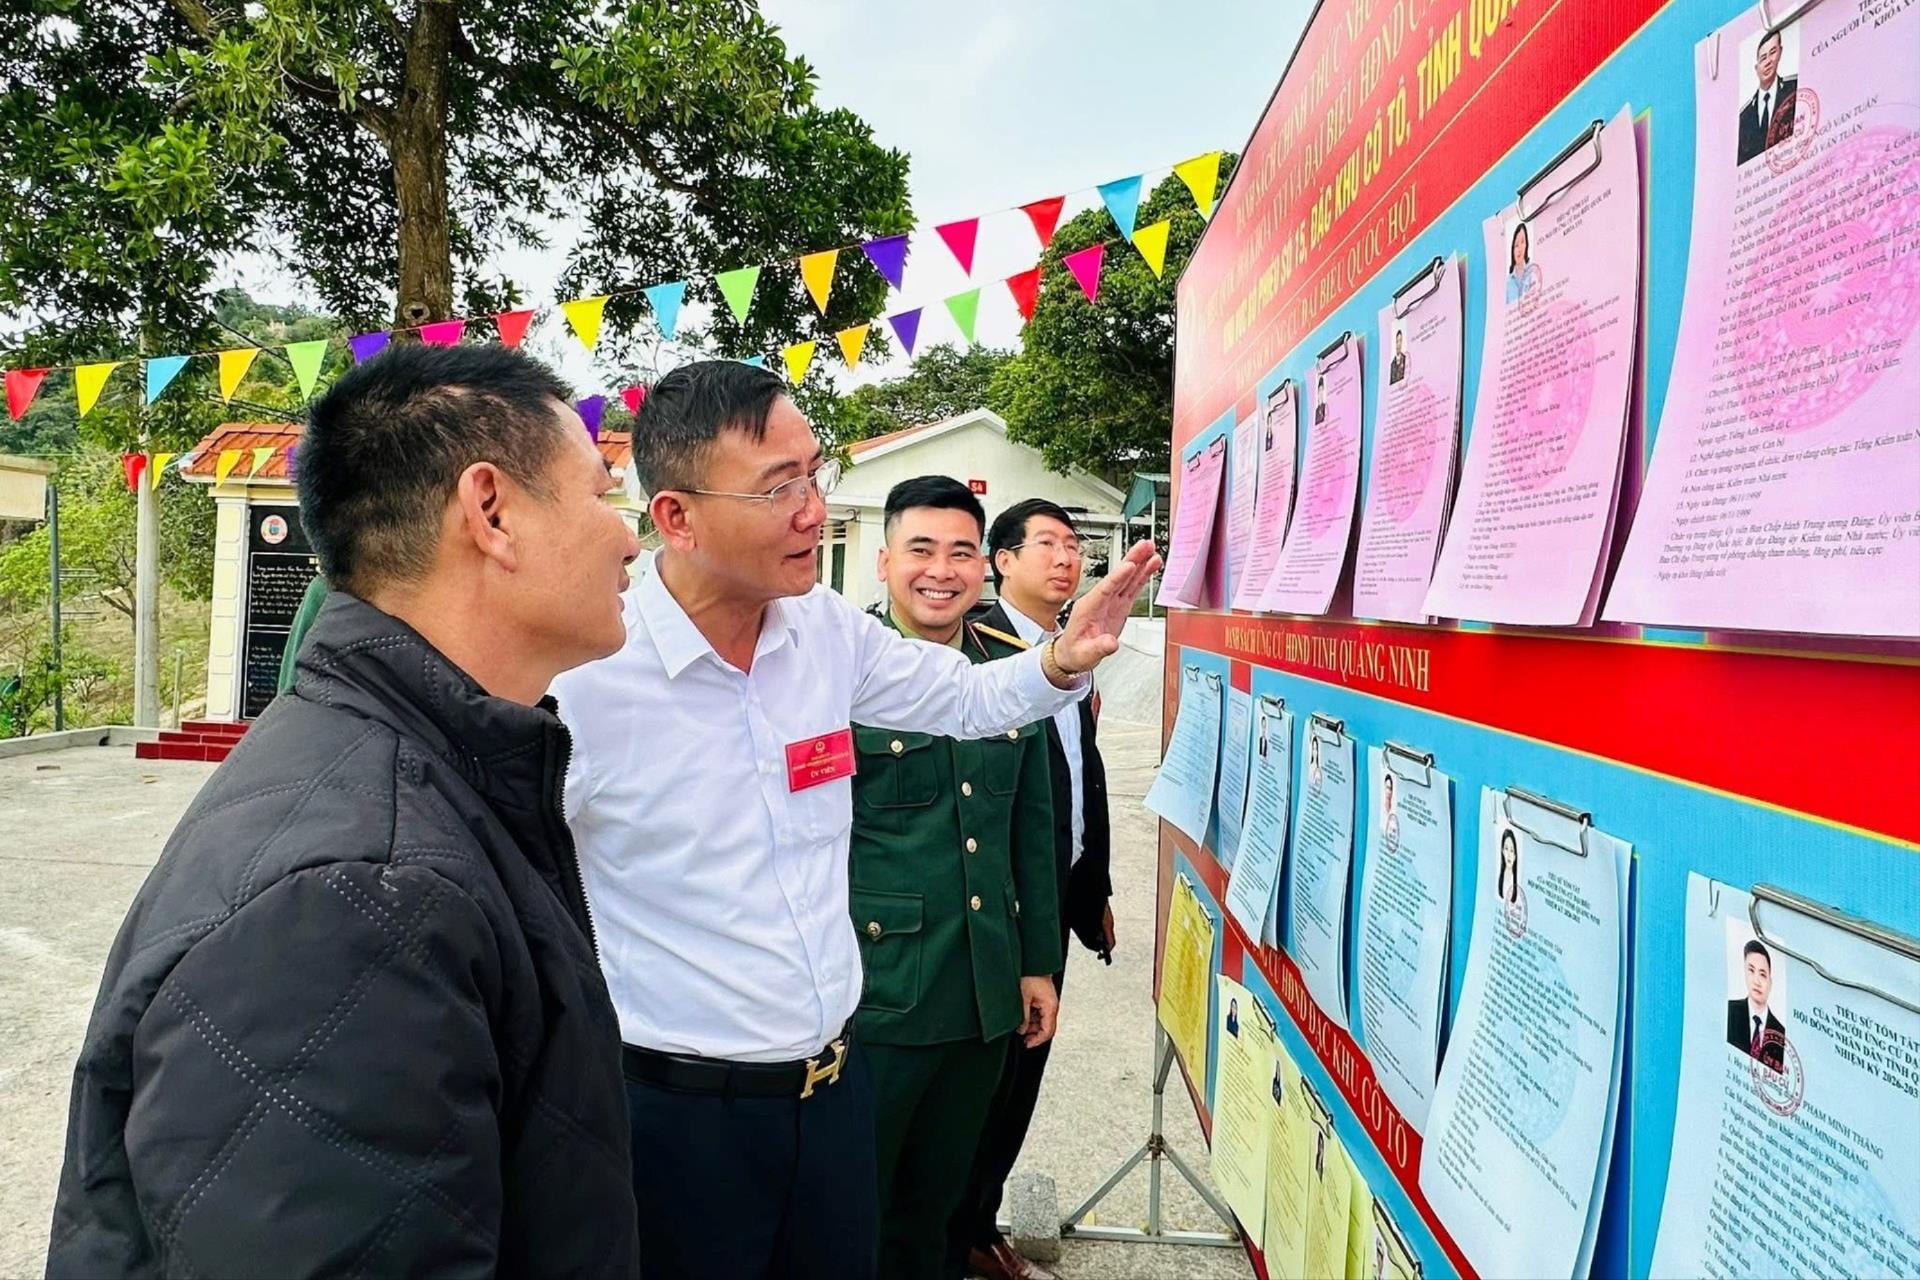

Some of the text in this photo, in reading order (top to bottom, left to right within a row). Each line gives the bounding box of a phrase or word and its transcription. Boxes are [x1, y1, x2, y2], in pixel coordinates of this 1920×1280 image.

[1360, 4, 1404, 108] HĐND
[1311, 184, 1331, 251] ĐẶC
[1335, 146, 1359, 220] KHU
[1363, 107, 1381, 186] CÔ
[1417, 13, 1461, 120] TỈNH
[1320, 260, 1342, 310] BIỂU
[1347, 217, 1384, 288] QUỐC
[1388, 183, 1415, 246] HỘI
[1802, 518, 1825, 534] Trung
[1285, 632, 1310, 665] HĐND
[1312, 627, 1337, 671] TỈNH
[1340, 631, 1385, 682] QUẢNG
[1389, 646, 1429, 691] NINH
[1812, 1006, 1902, 1059] CỦA NGƯỜI ỨNG CỬ
[1835, 1004, 1857, 1023] TIỂU
[1859, 1015, 1872, 1029] SỬ
[1874, 1022, 1897, 1042] TÓM
[1793, 1008, 1807, 1024] HỘI
[1810, 1017, 1833, 1038] ĐỒNG
[1835, 1031, 1860, 1052] NHÂN
[1863, 1045, 1882, 1063] DÂN
[1885, 1056, 1909, 1078] TỈNH
[1834, 1044, 1865, 1069] NHIỆM
[1867, 1062, 1880, 1076] KỲ
[1281, 964, 1307, 1019] HĐND
[1333, 1035, 1360, 1097] KHU
[1361, 1076, 1382, 1132] CÔ
[1385, 1104, 1407, 1168] TÔ
[1814, 1127, 1836, 1150] MINH
[1828, 1115, 1850, 1138] MINH
[1824, 1154, 1848, 1181] Không
[1849, 1173, 1859, 1185] có
[1804, 1215, 1826, 1242] Quảng
[1828, 1232, 1846, 1255] Ninh
[1870, 1227, 1886, 1249] Việt
[1890, 1242, 1908, 1265] Nam
[1872, 1249, 1884, 1264] gia
[1886, 1256, 1905, 1280] khác
